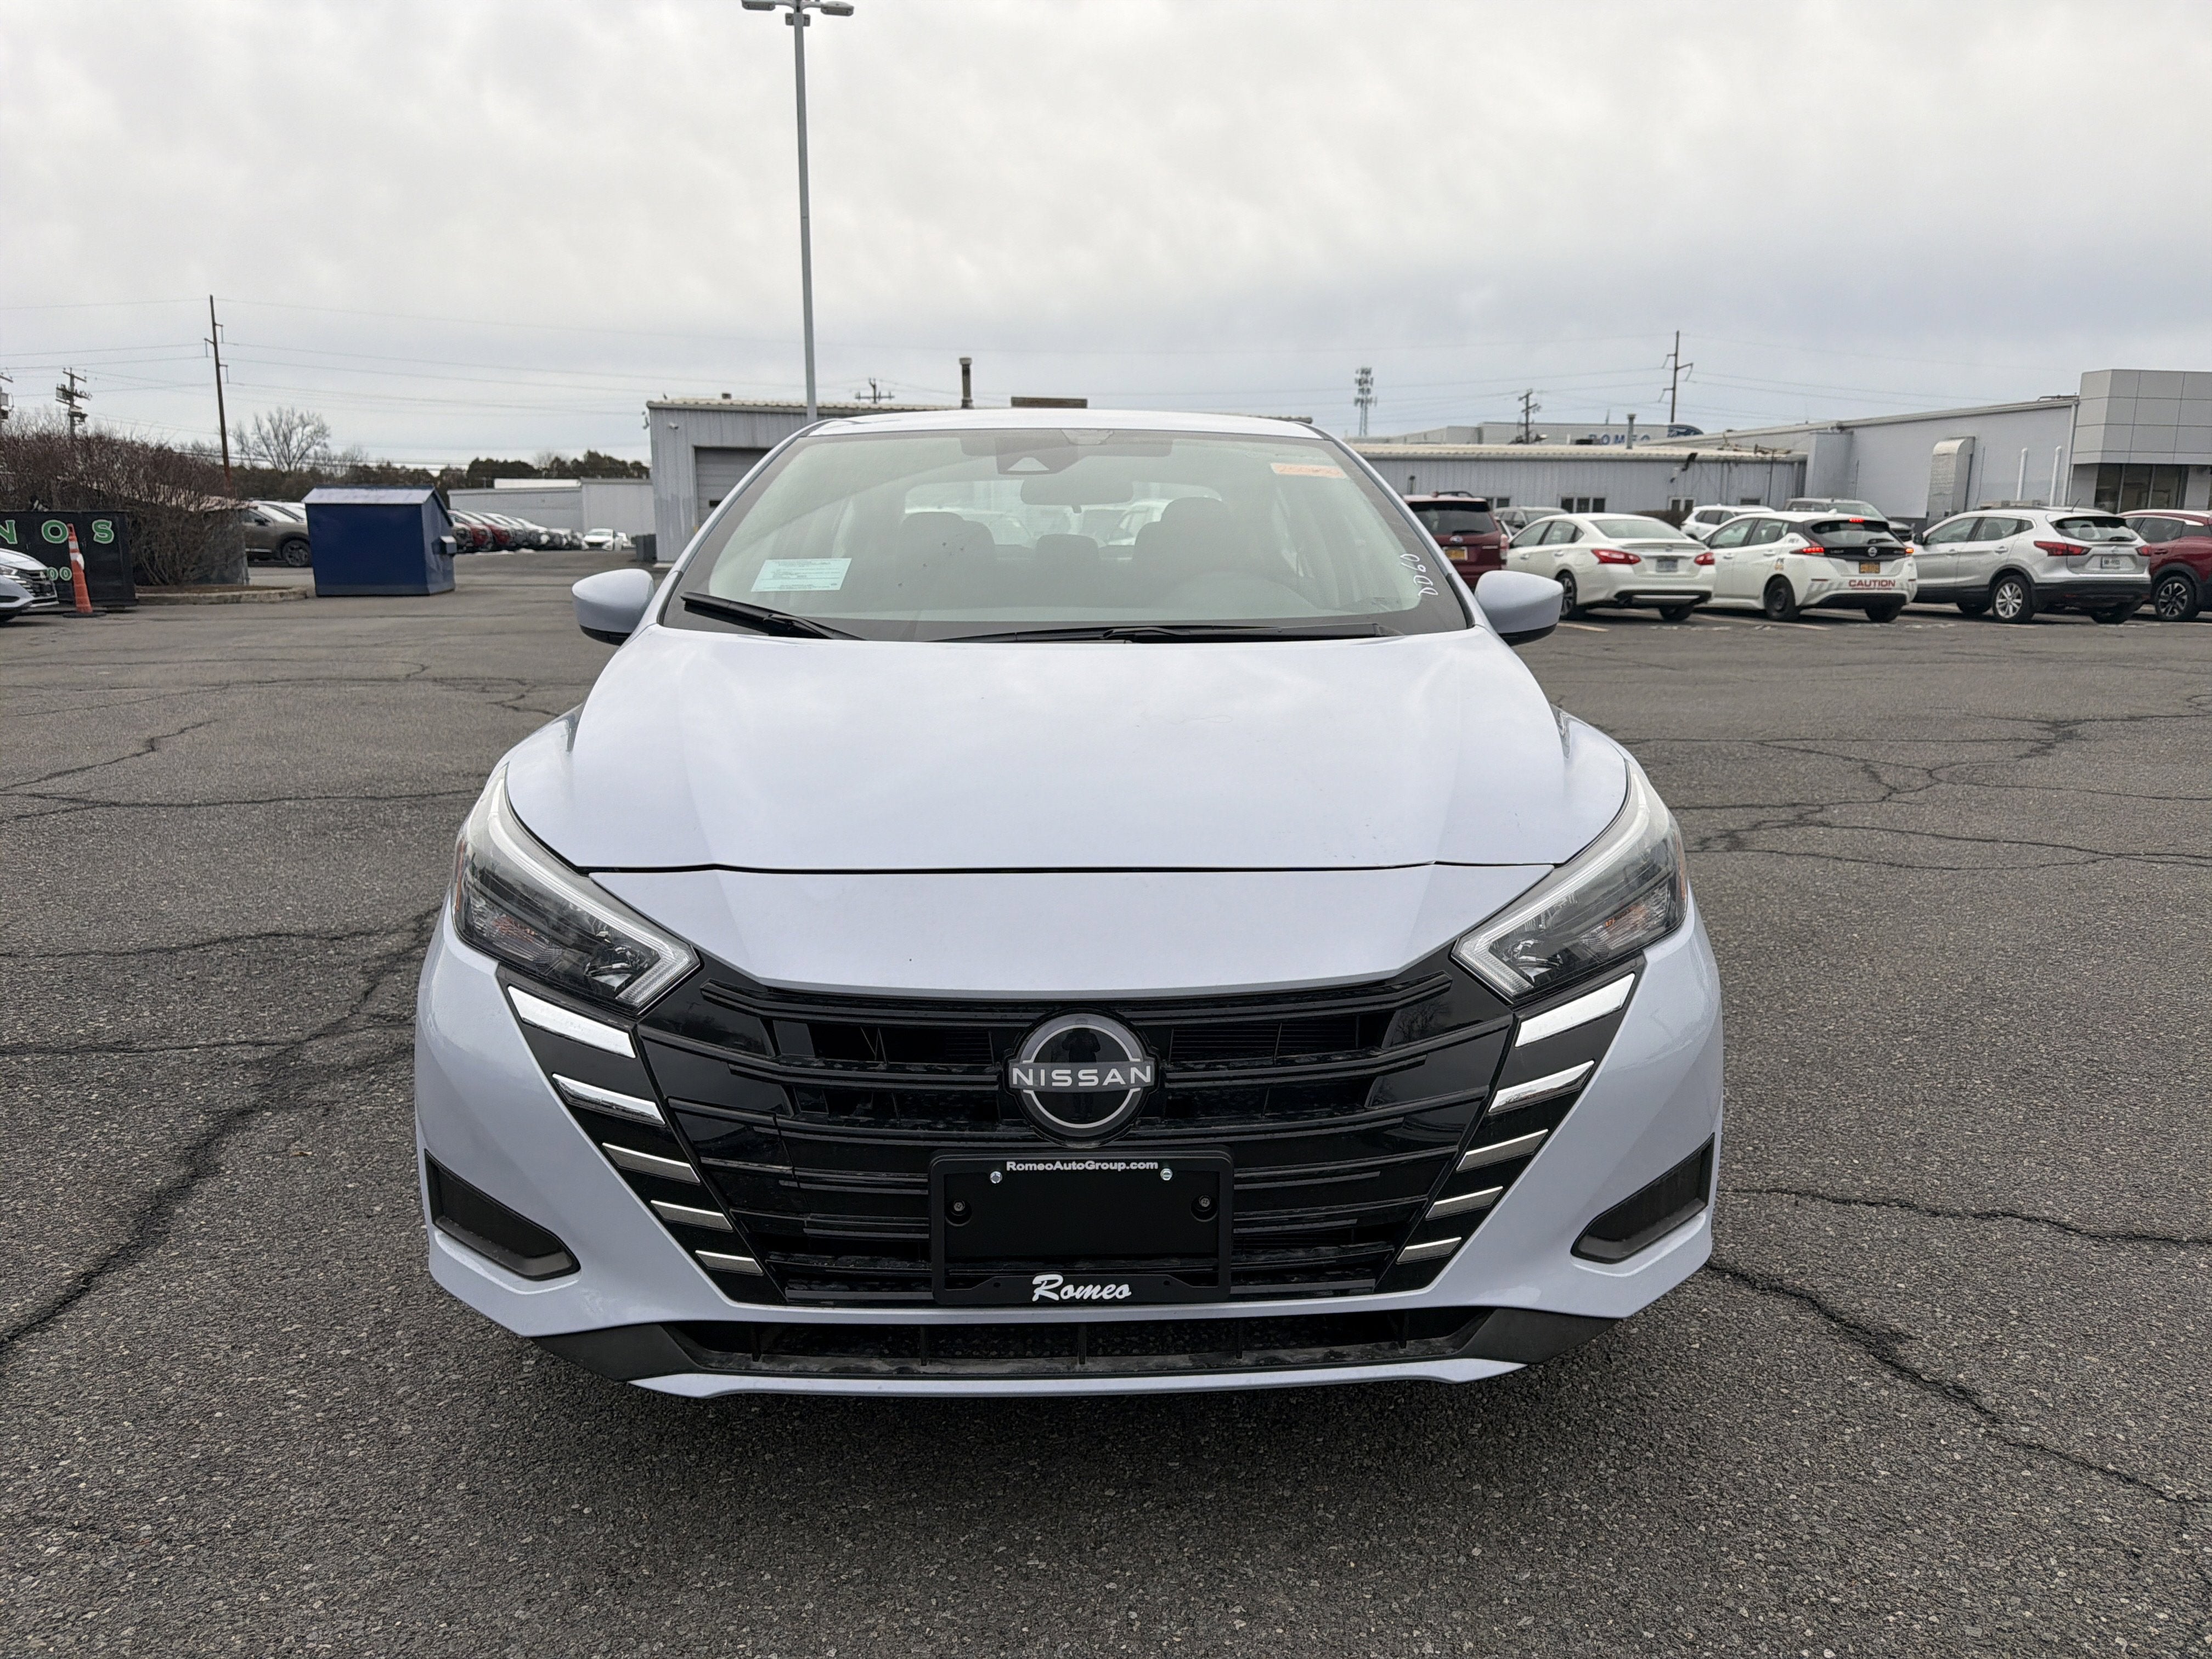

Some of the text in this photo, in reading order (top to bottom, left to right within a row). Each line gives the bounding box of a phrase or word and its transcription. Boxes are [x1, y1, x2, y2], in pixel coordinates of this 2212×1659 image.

[1013, 1065, 1151, 1086] NISSAN
[1006, 1160, 1158, 1171] RomeoAutoGroup.com
[1032, 1274, 1131, 1302] Romeo
